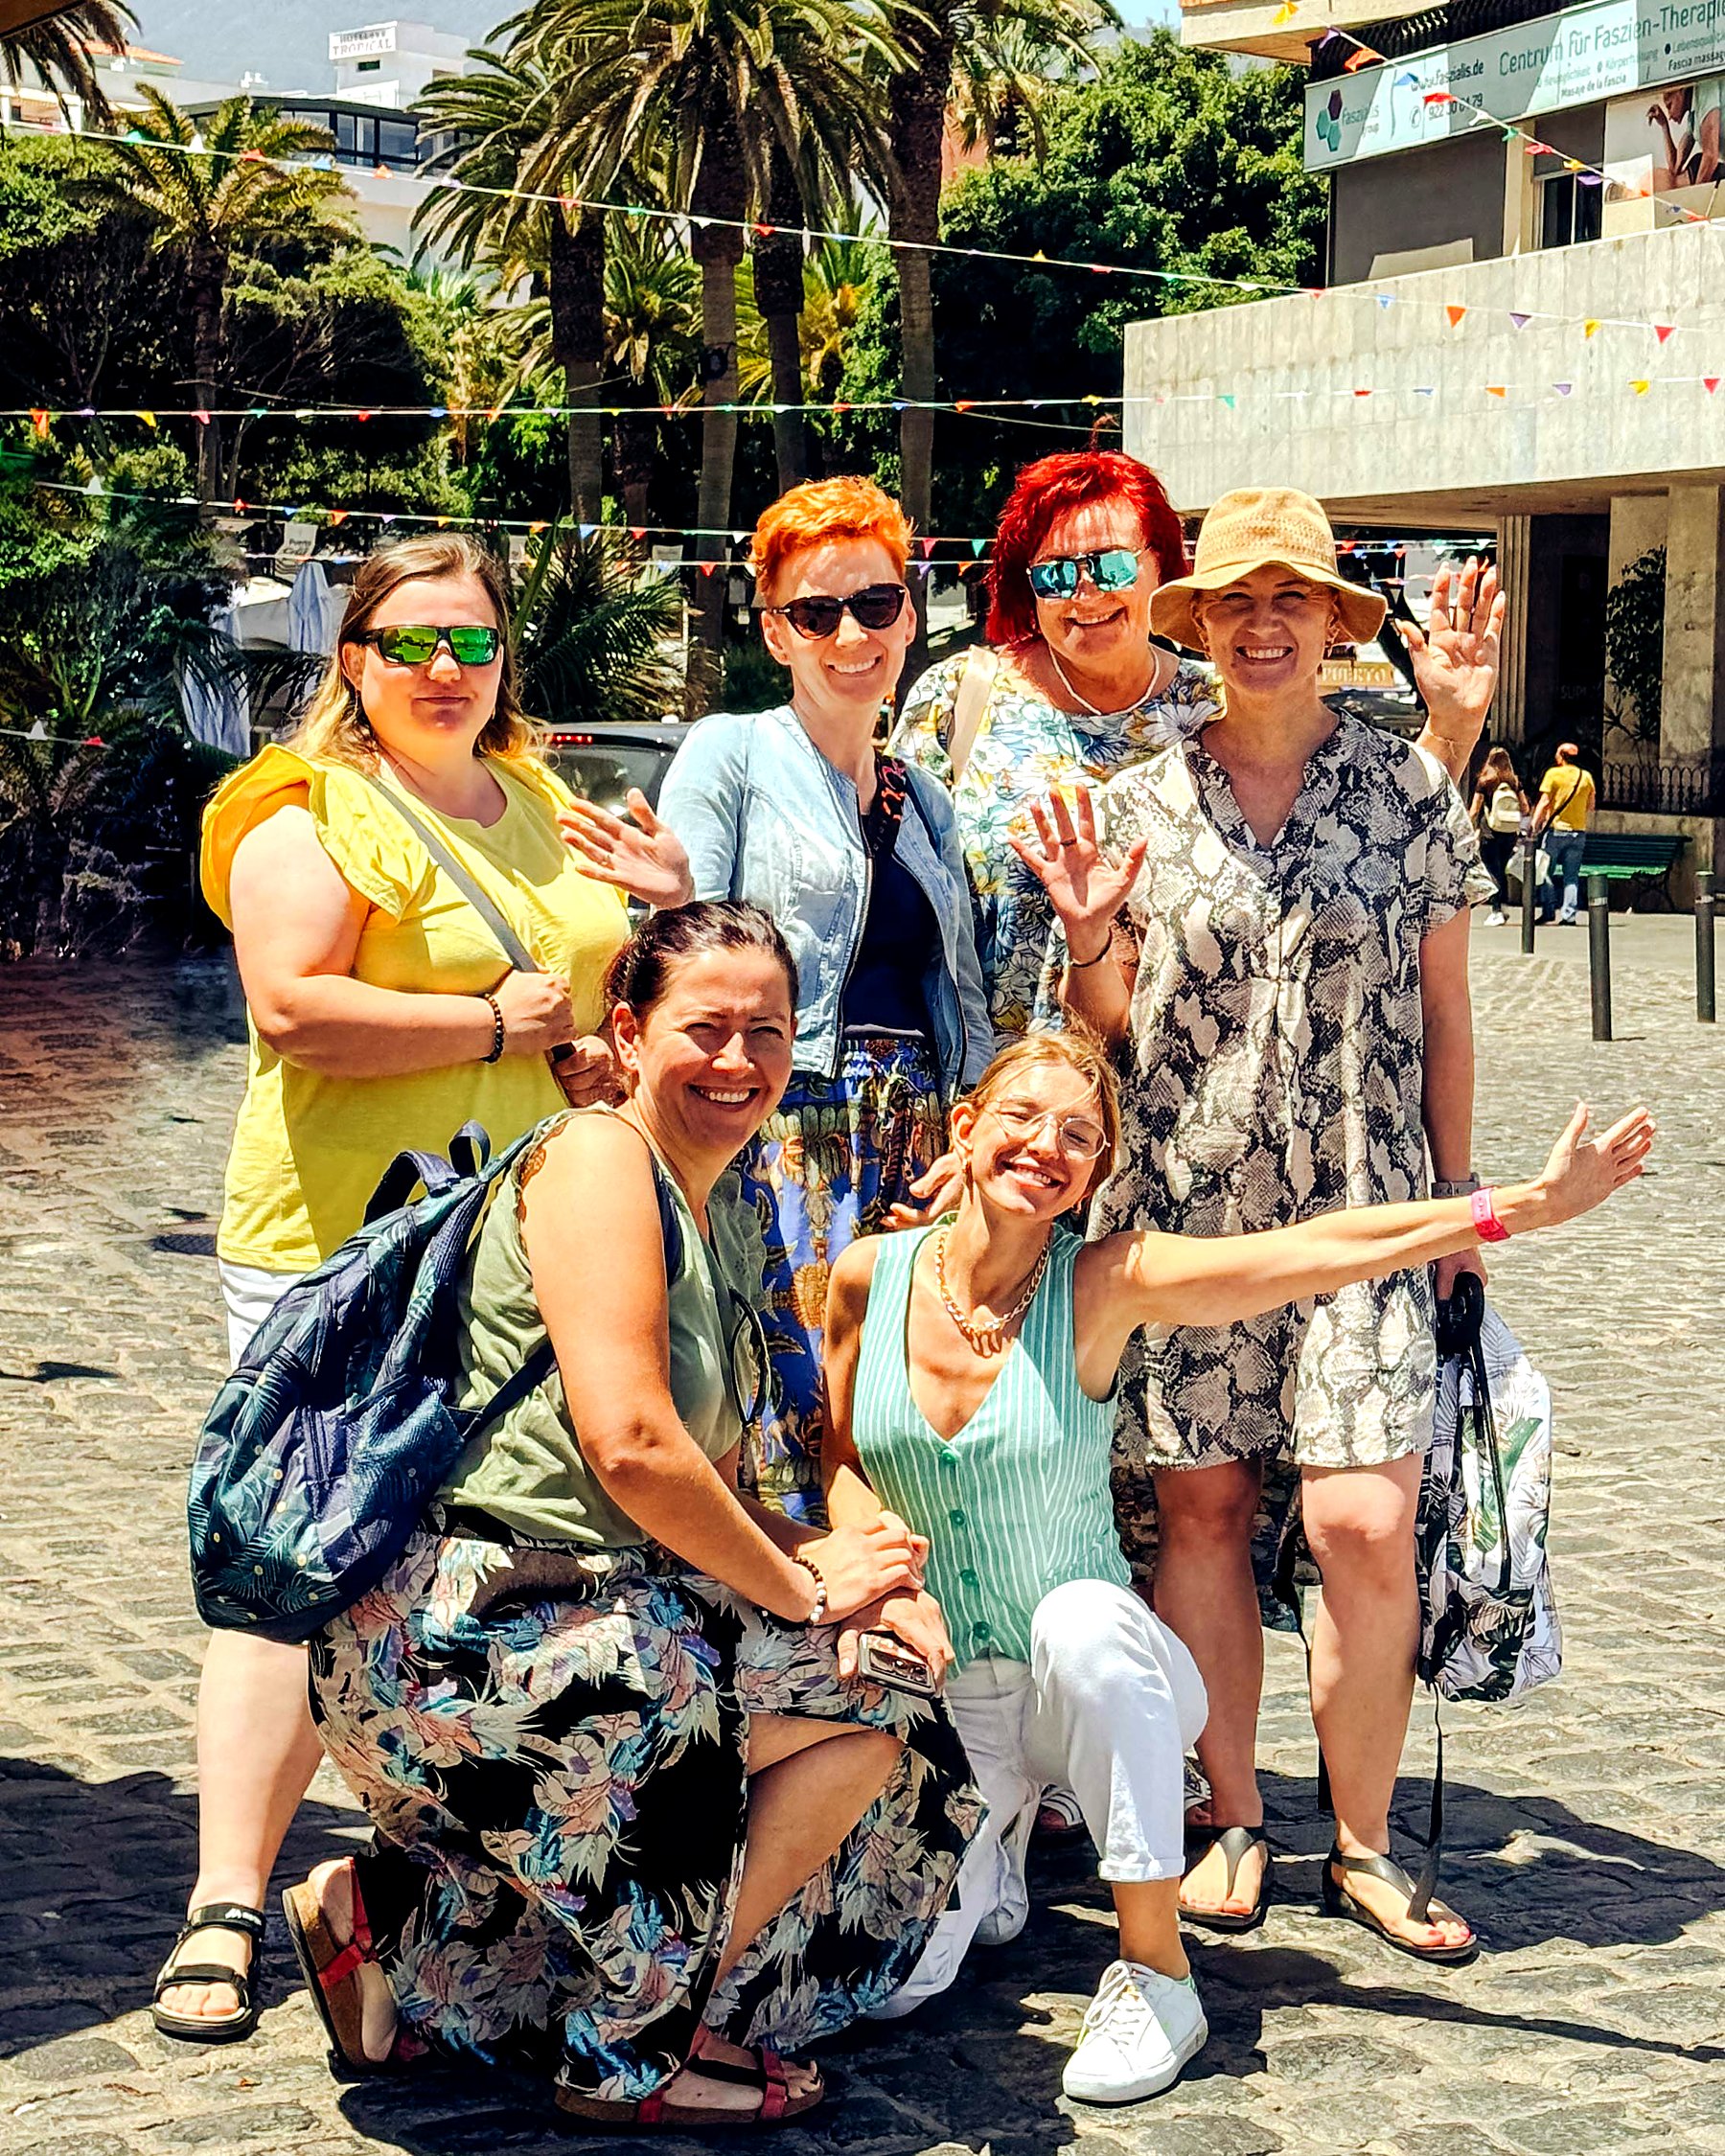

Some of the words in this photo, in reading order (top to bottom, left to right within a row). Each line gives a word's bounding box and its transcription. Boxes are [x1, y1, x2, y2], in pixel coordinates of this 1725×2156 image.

[333, 38, 392, 56] TROPICAL
[1500, 43, 1563, 77] Centrum
[1569, 30, 1591, 57] für
[1322, 667, 1387, 683] PUERTO
